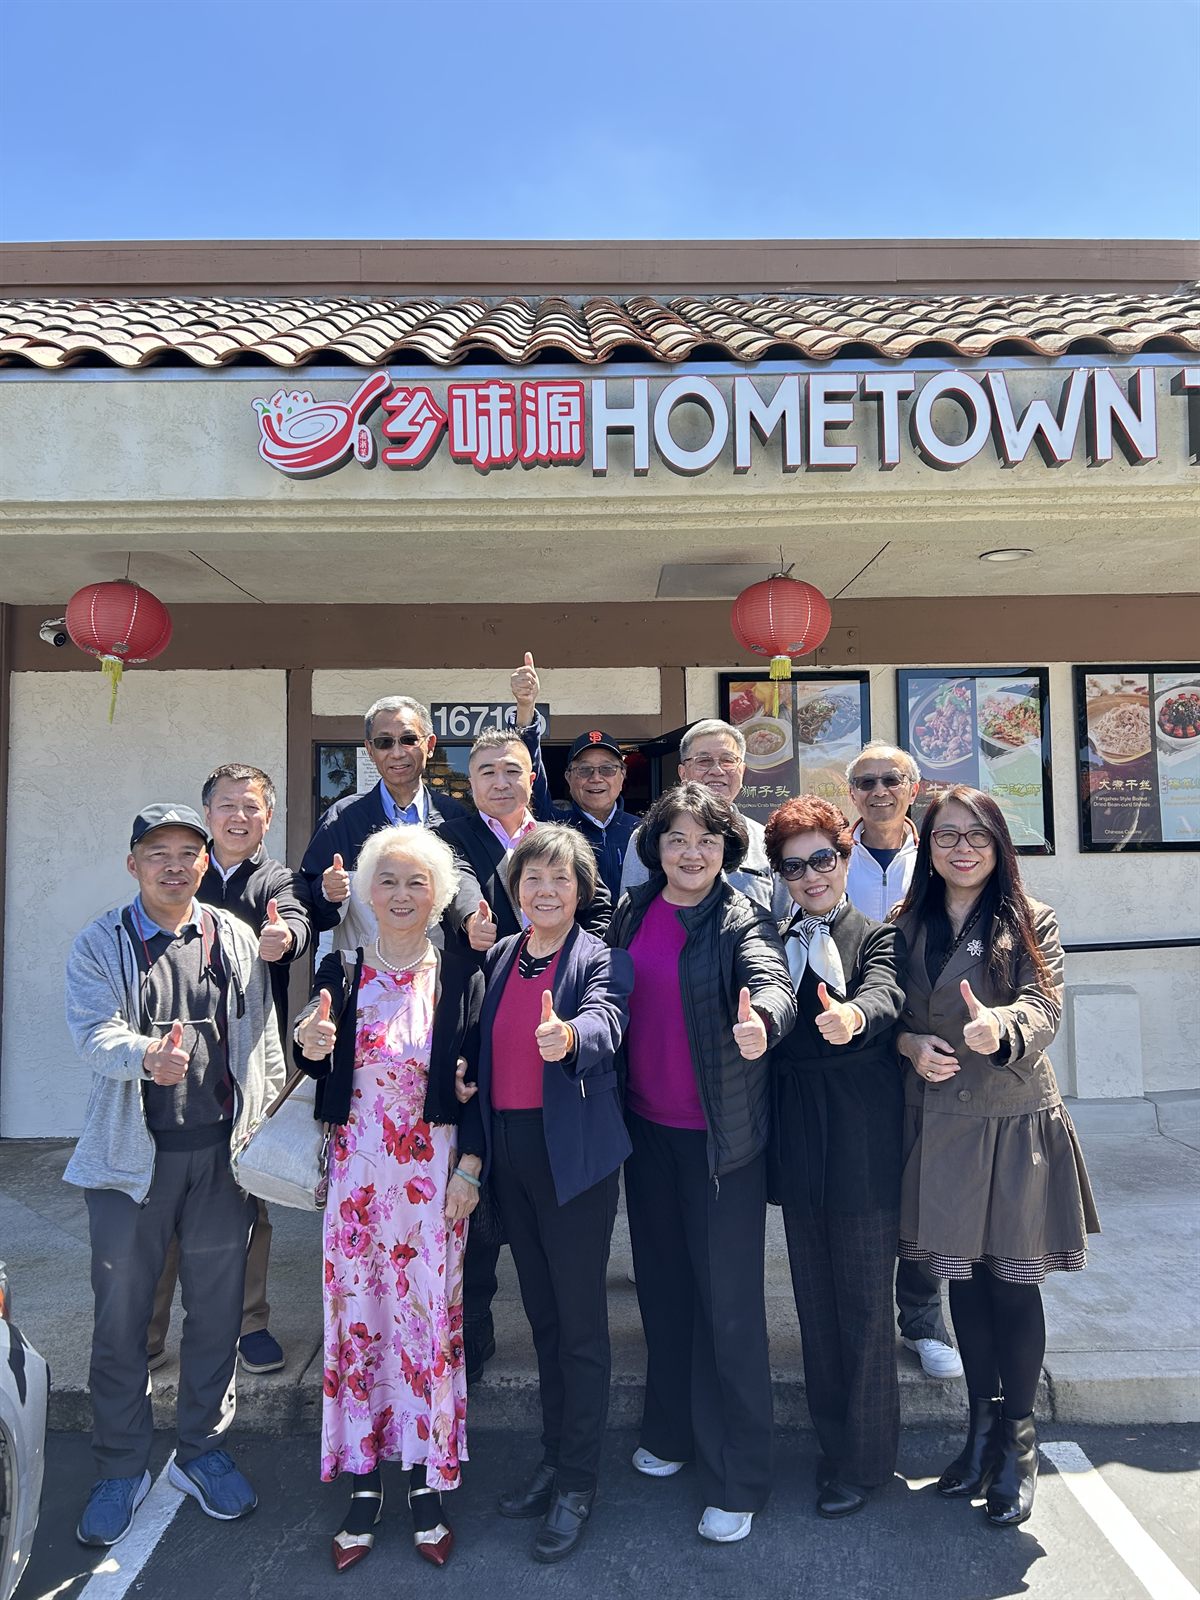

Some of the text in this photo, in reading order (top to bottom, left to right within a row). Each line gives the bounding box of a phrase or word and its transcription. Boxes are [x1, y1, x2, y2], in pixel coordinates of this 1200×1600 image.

[591, 367, 1158, 472] HOMETOWN
[434, 705, 547, 737] 1671
[741, 785, 791, 798] 狮子头
[1099, 779, 1152, 791] 大煮干丝
